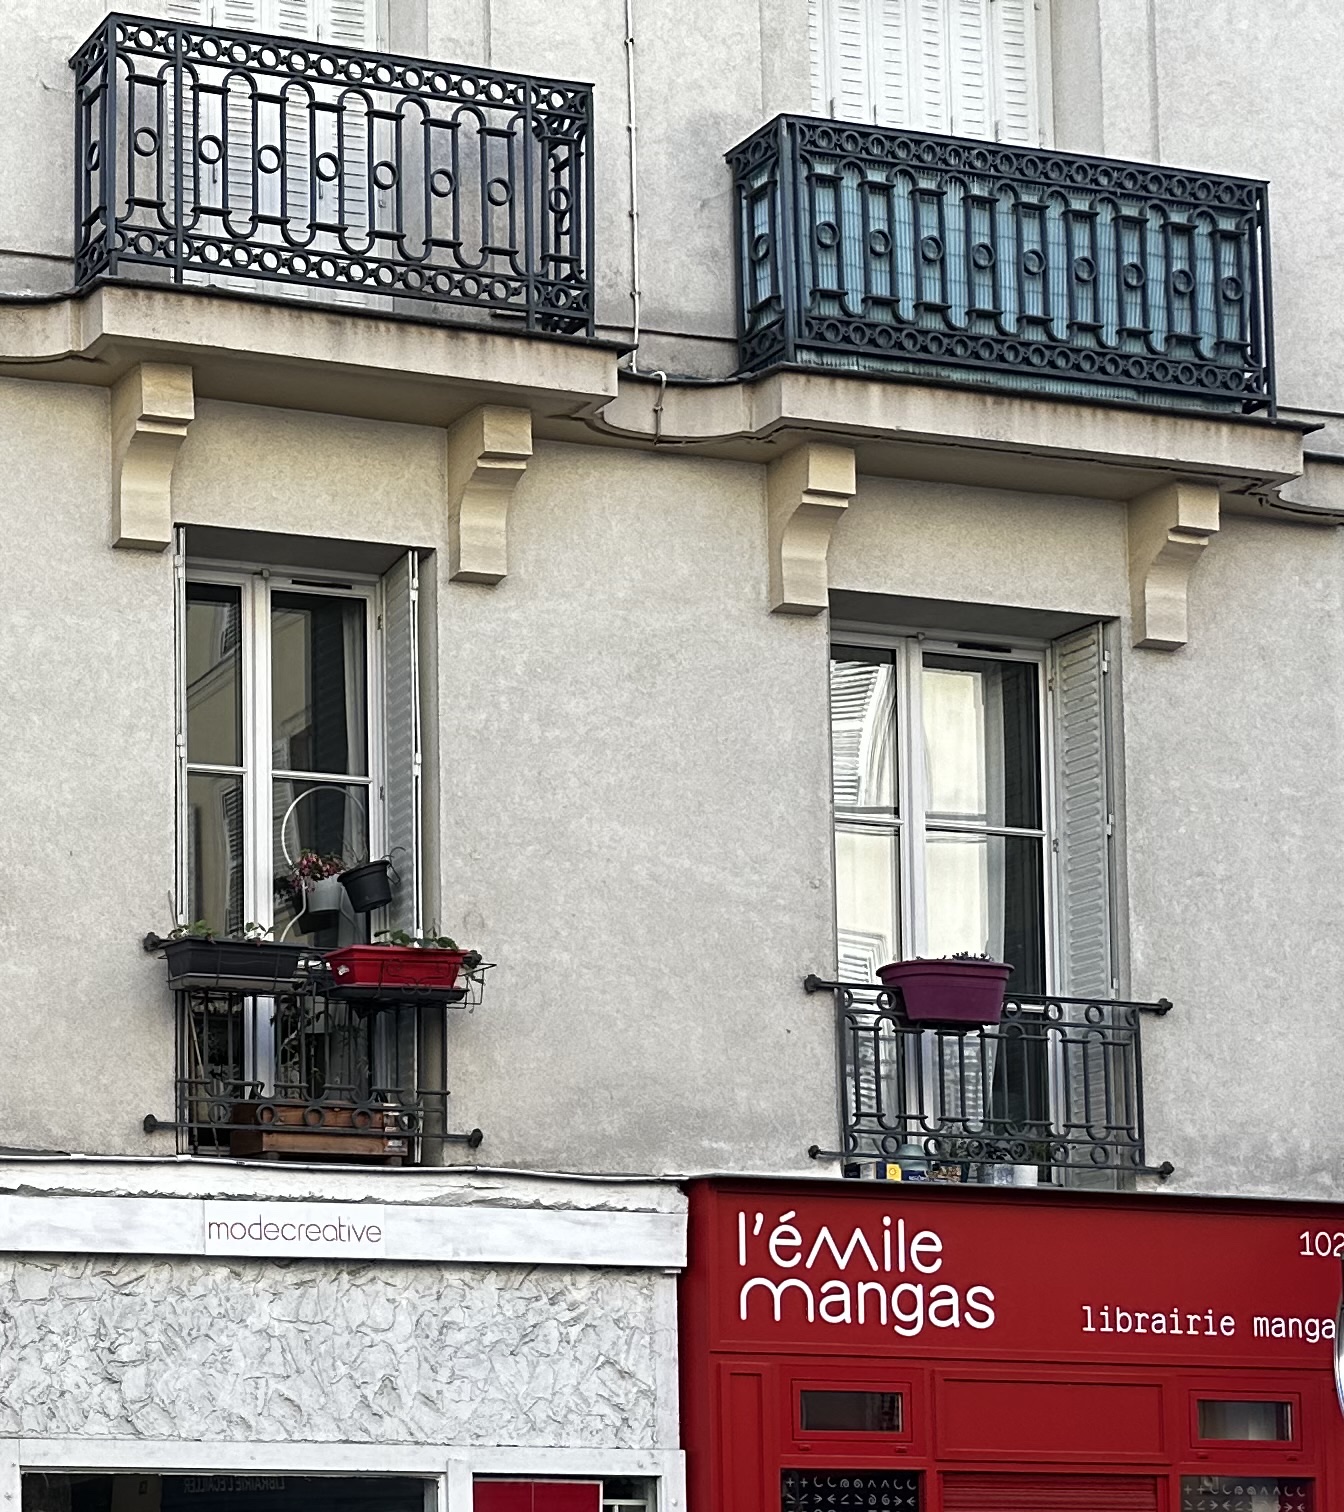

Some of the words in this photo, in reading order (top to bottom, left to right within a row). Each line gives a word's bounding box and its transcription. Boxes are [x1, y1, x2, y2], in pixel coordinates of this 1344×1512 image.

[208, 1213, 382, 1243] modecreative
[737, 1209, 944, 1275] l'émile
[739, 1276, 997, 1337] mangas
[1081, 1306, 1236, 1337] librairie
